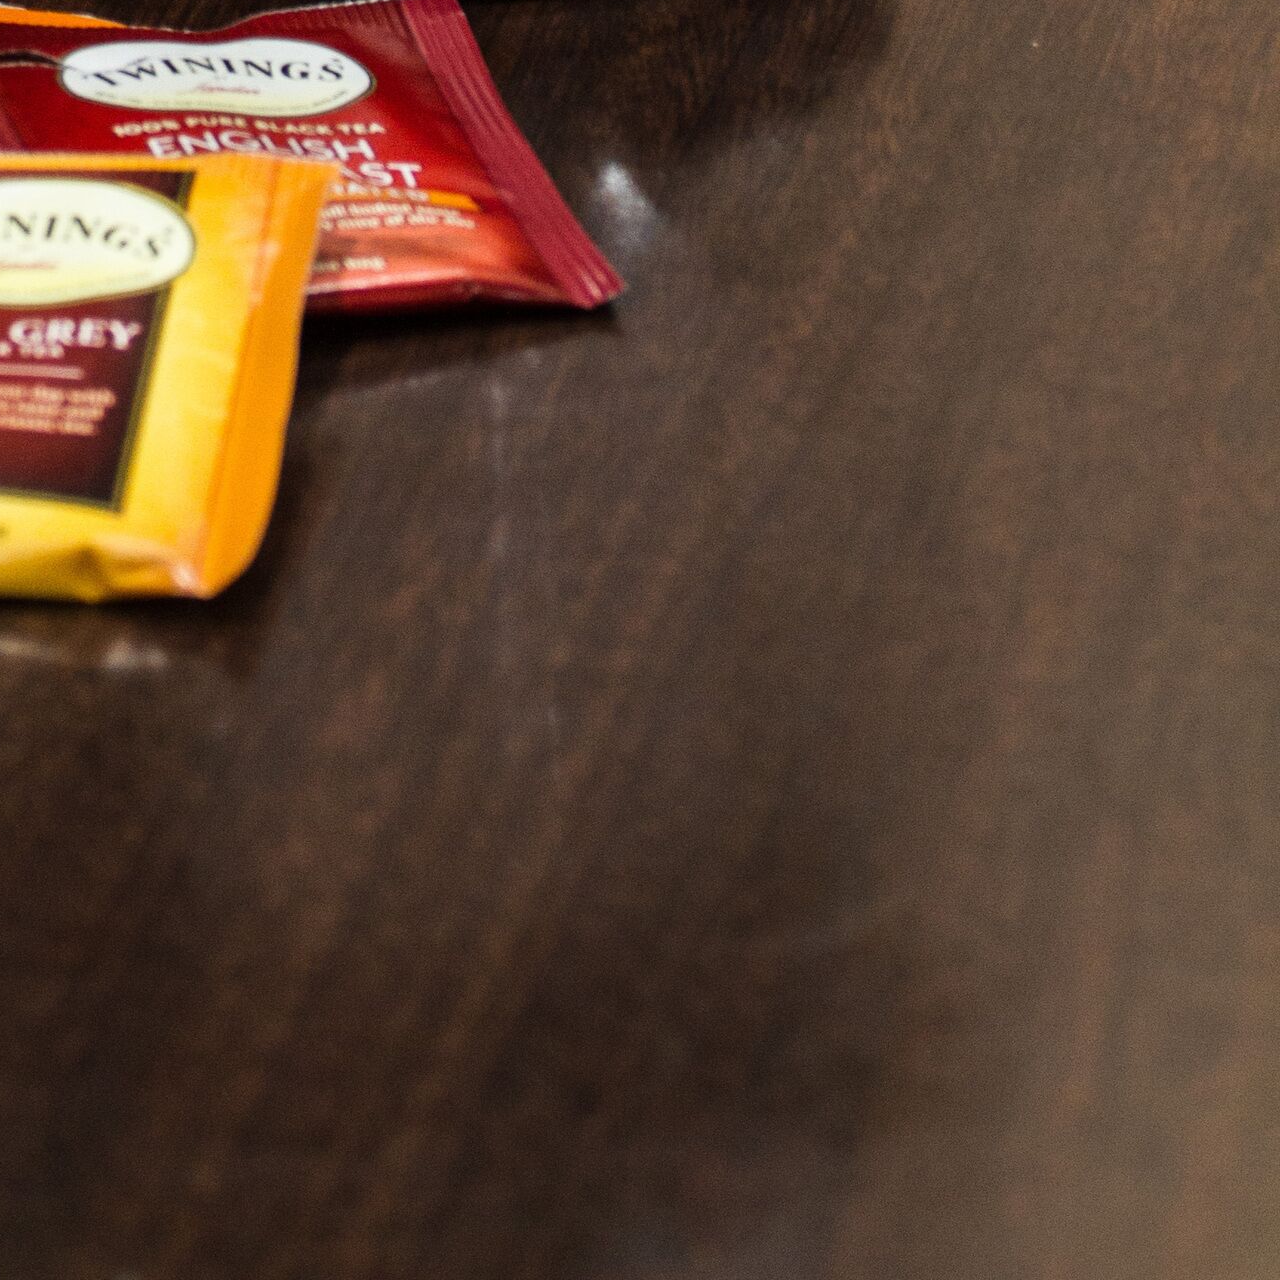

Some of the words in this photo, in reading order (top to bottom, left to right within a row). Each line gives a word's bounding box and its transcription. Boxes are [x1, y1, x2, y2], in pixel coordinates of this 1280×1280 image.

[82, 55, 346, 88] TWININGS
[336, 121, 387, 136] TEA
[146, 129, 377, 161] ENGLISH
[8, 316, 143, 351] GREY
